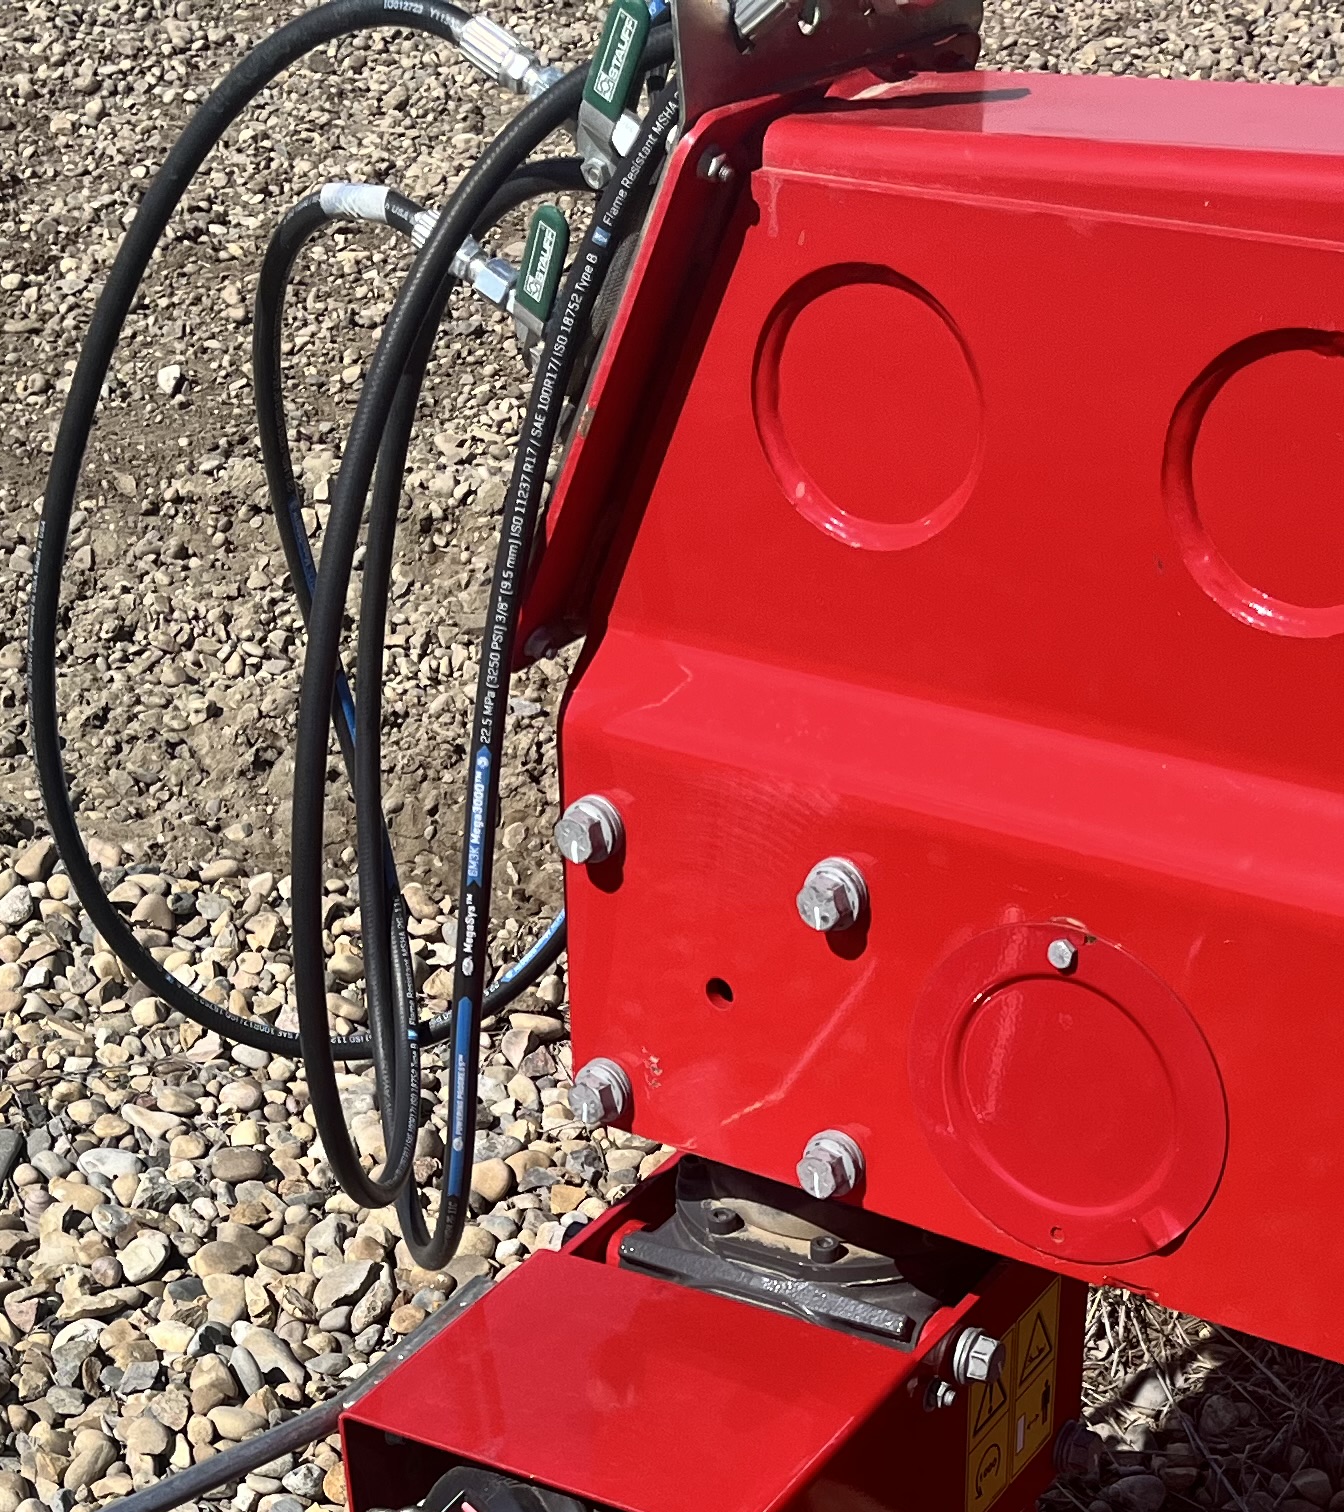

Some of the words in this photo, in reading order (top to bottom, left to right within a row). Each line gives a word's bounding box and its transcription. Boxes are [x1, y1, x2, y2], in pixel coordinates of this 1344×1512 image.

[602, 189, 628, 227] Flame
[620, 133, 658, 189] Resistant
[651, 101, 678, 136] MSHA
[586, 252, 598, 264] B
[574, 263, 594, 292] Type
[560, 293, 583, 334] 18752
[552, 335, 568, 358] ISO
[530, 412, 546, 438] SAE
[522, 446, 537, 473] R17
[514, 473, 531, 515] 11237
[510, 515, 524, 538] ISO
[490, 624, 508, 651] PSI)
[485, 653, 501, 689] (3250
[482, 690, 496, 716] MPa
[479, 718, 493, 744] 22.5
